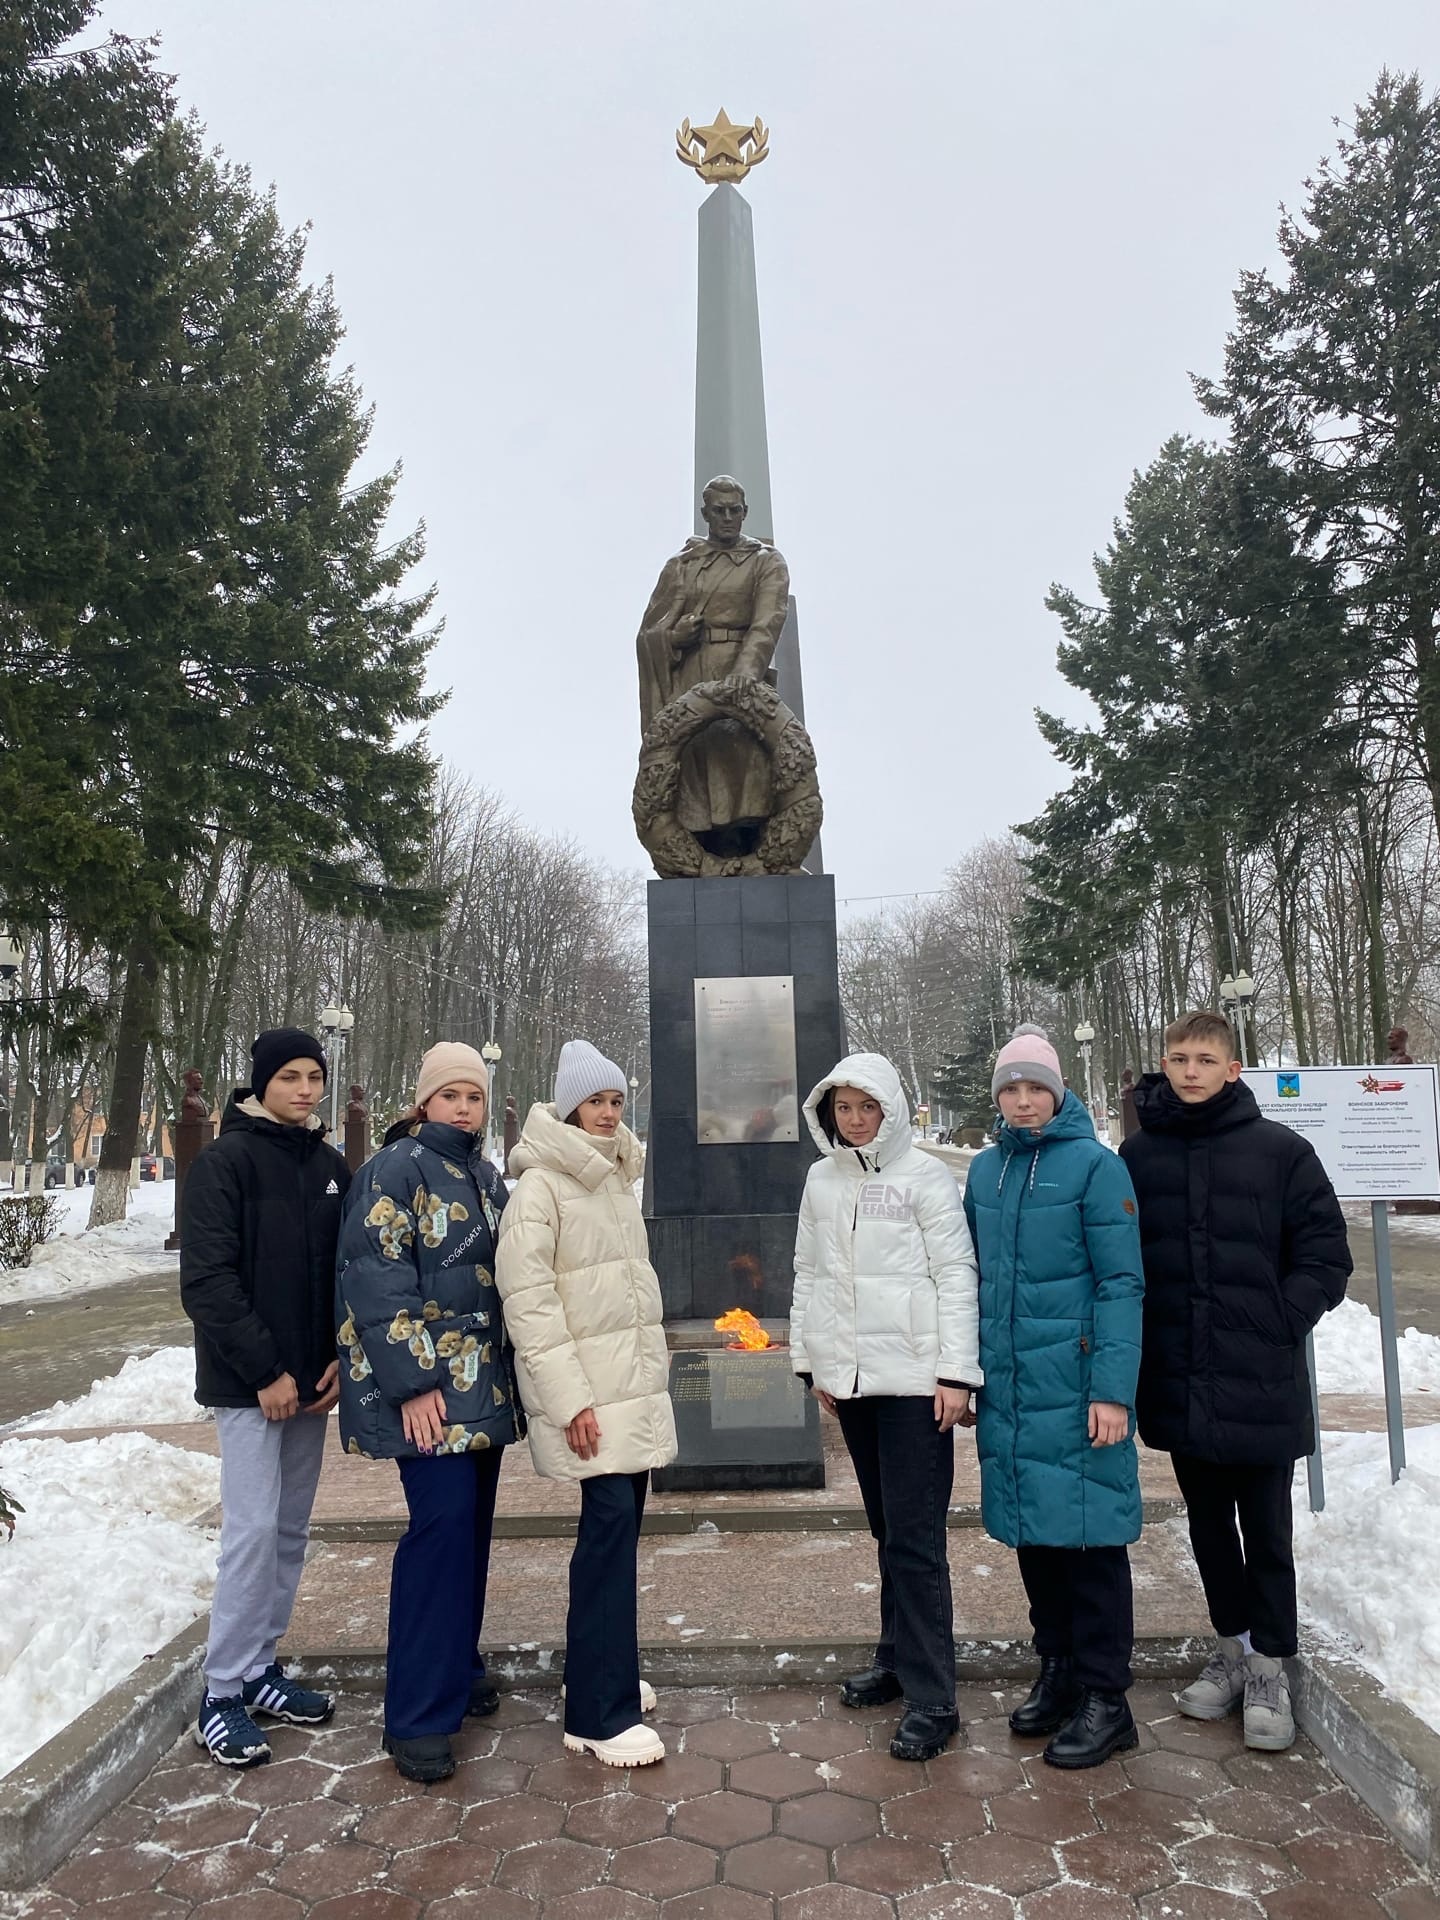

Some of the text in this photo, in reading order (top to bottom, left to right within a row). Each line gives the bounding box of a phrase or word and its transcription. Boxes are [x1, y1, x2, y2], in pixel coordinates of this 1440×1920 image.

[436, 1212, 445, 1234] ESSO
[441, 1224, 483, 1268] DOGOGAIN
[467, 1354, 475, 1378] ESSO
